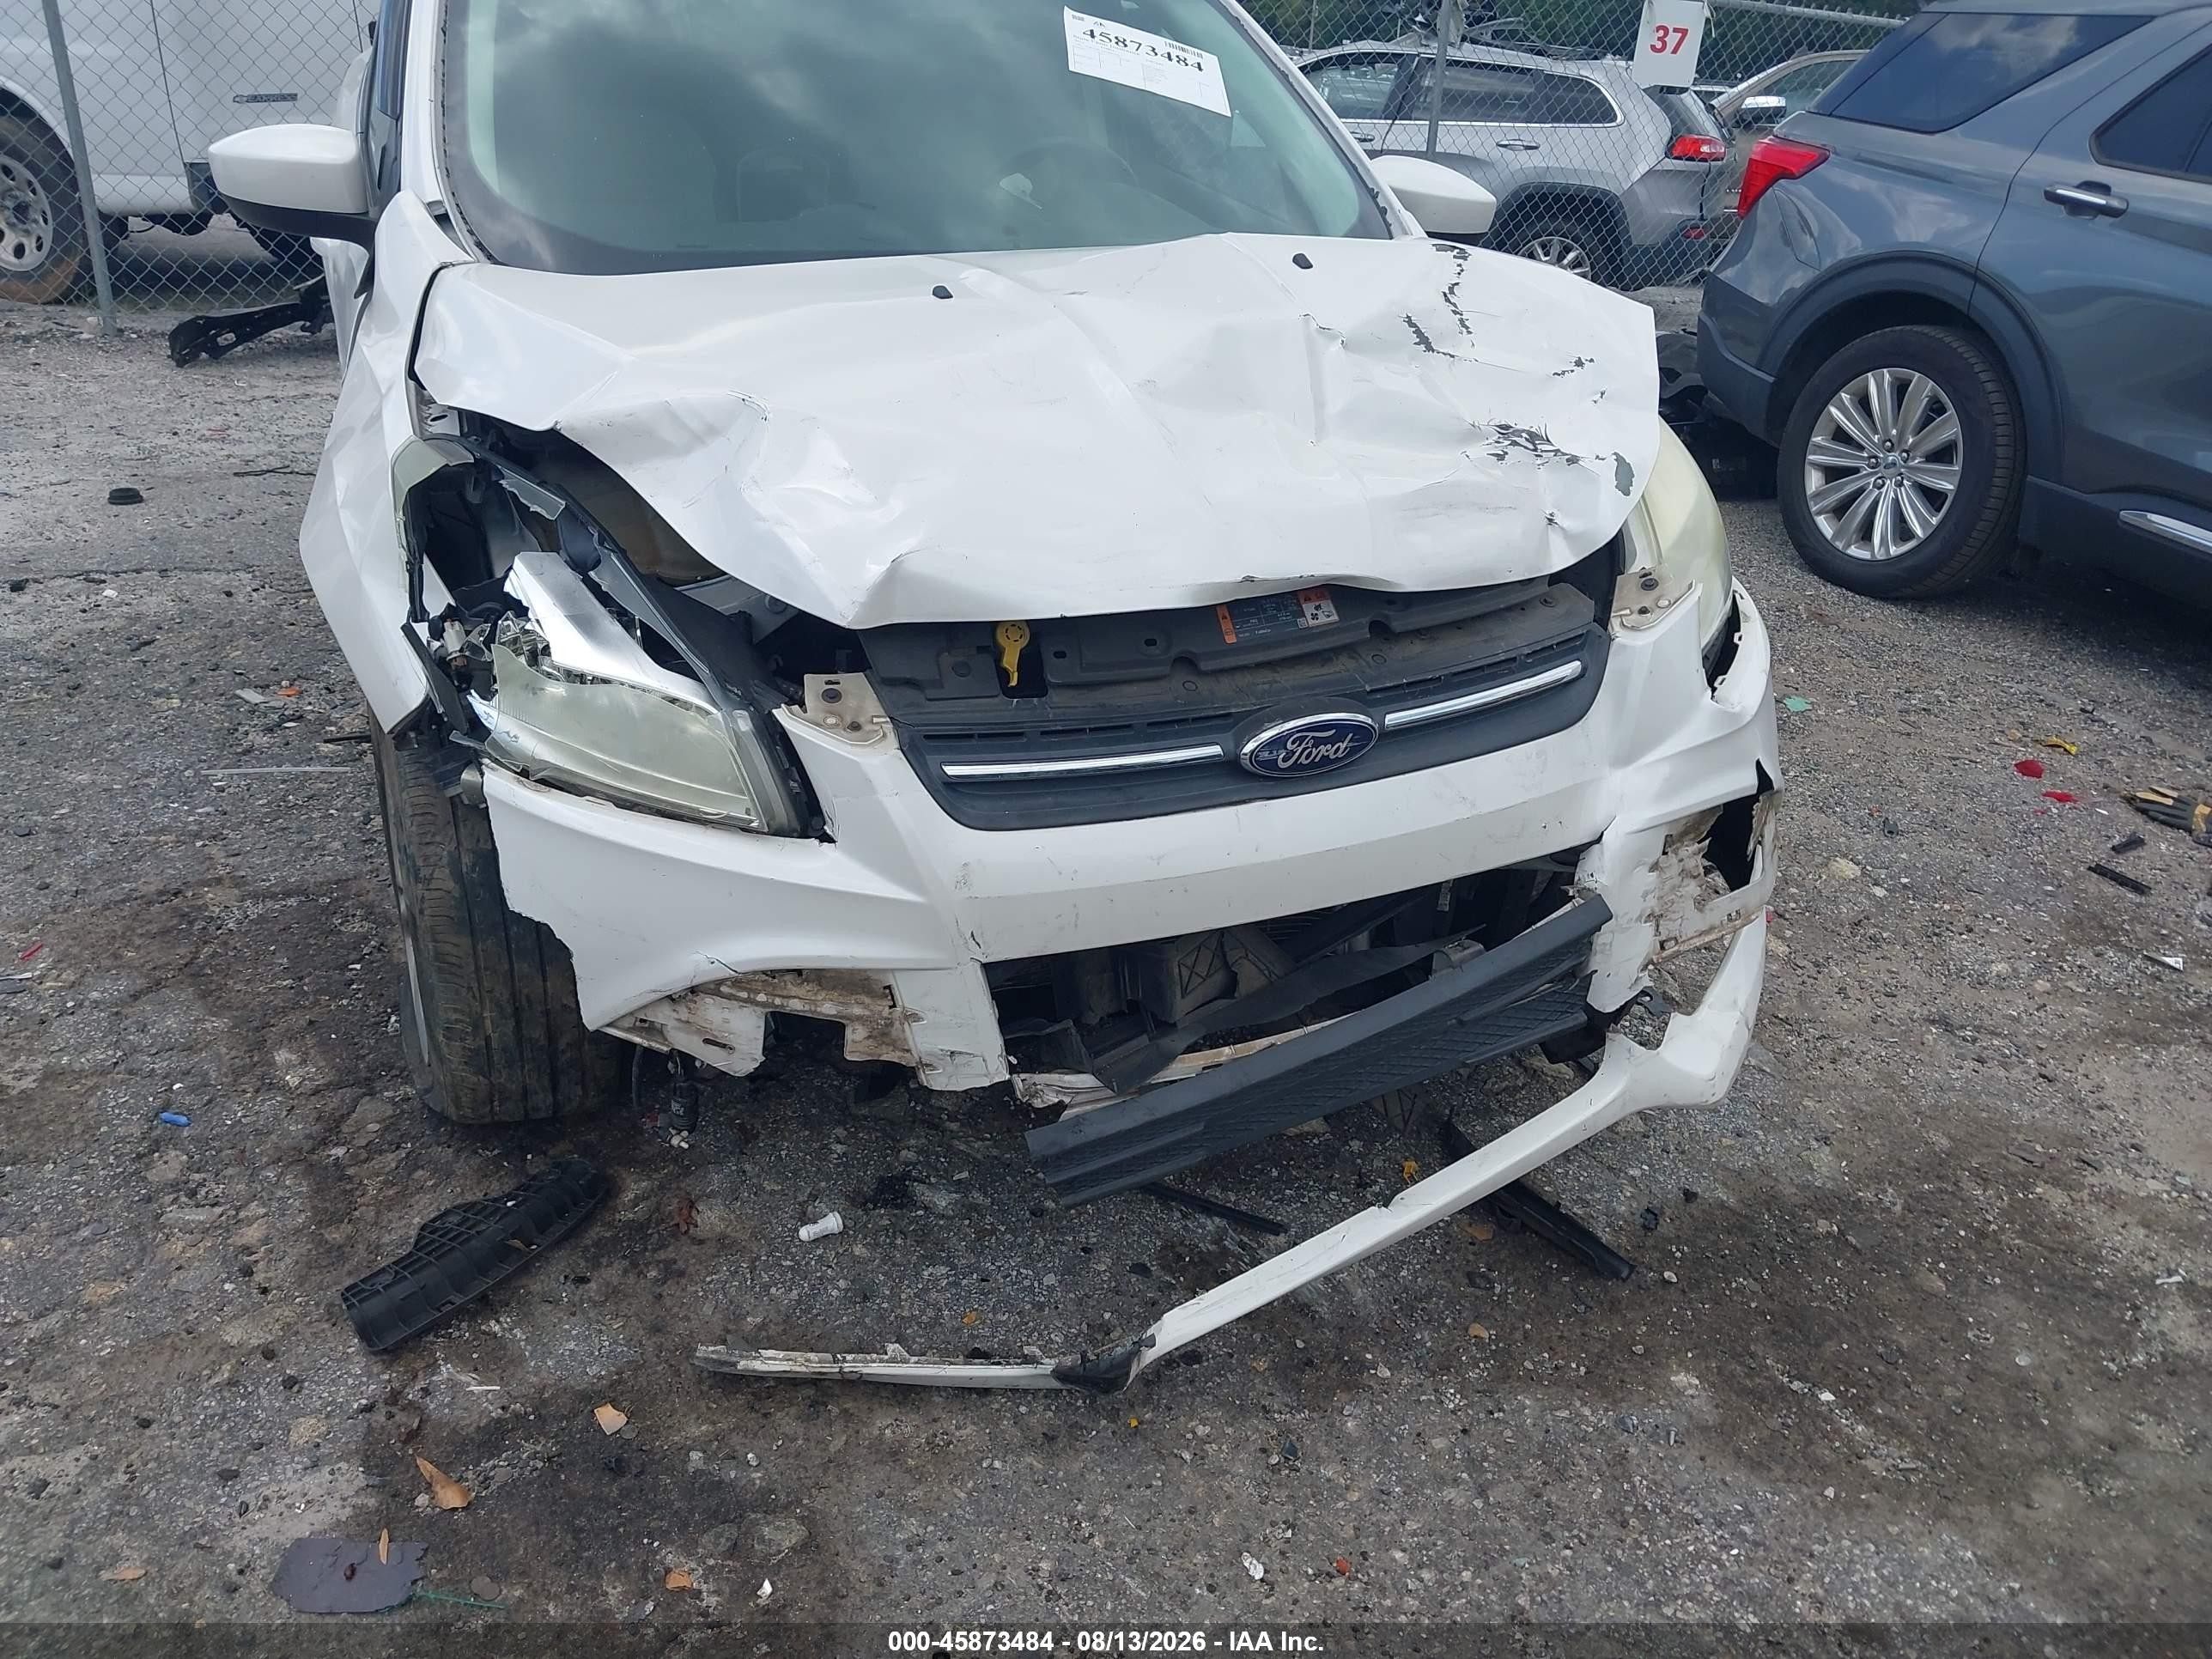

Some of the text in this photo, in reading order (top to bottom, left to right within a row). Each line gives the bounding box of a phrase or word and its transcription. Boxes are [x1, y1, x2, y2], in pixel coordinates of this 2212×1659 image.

[1083, 28, 1204, 72] 45873484
[1650, 24, 1689, 55] 37
[1277, 728, 1354, 769] Ford
